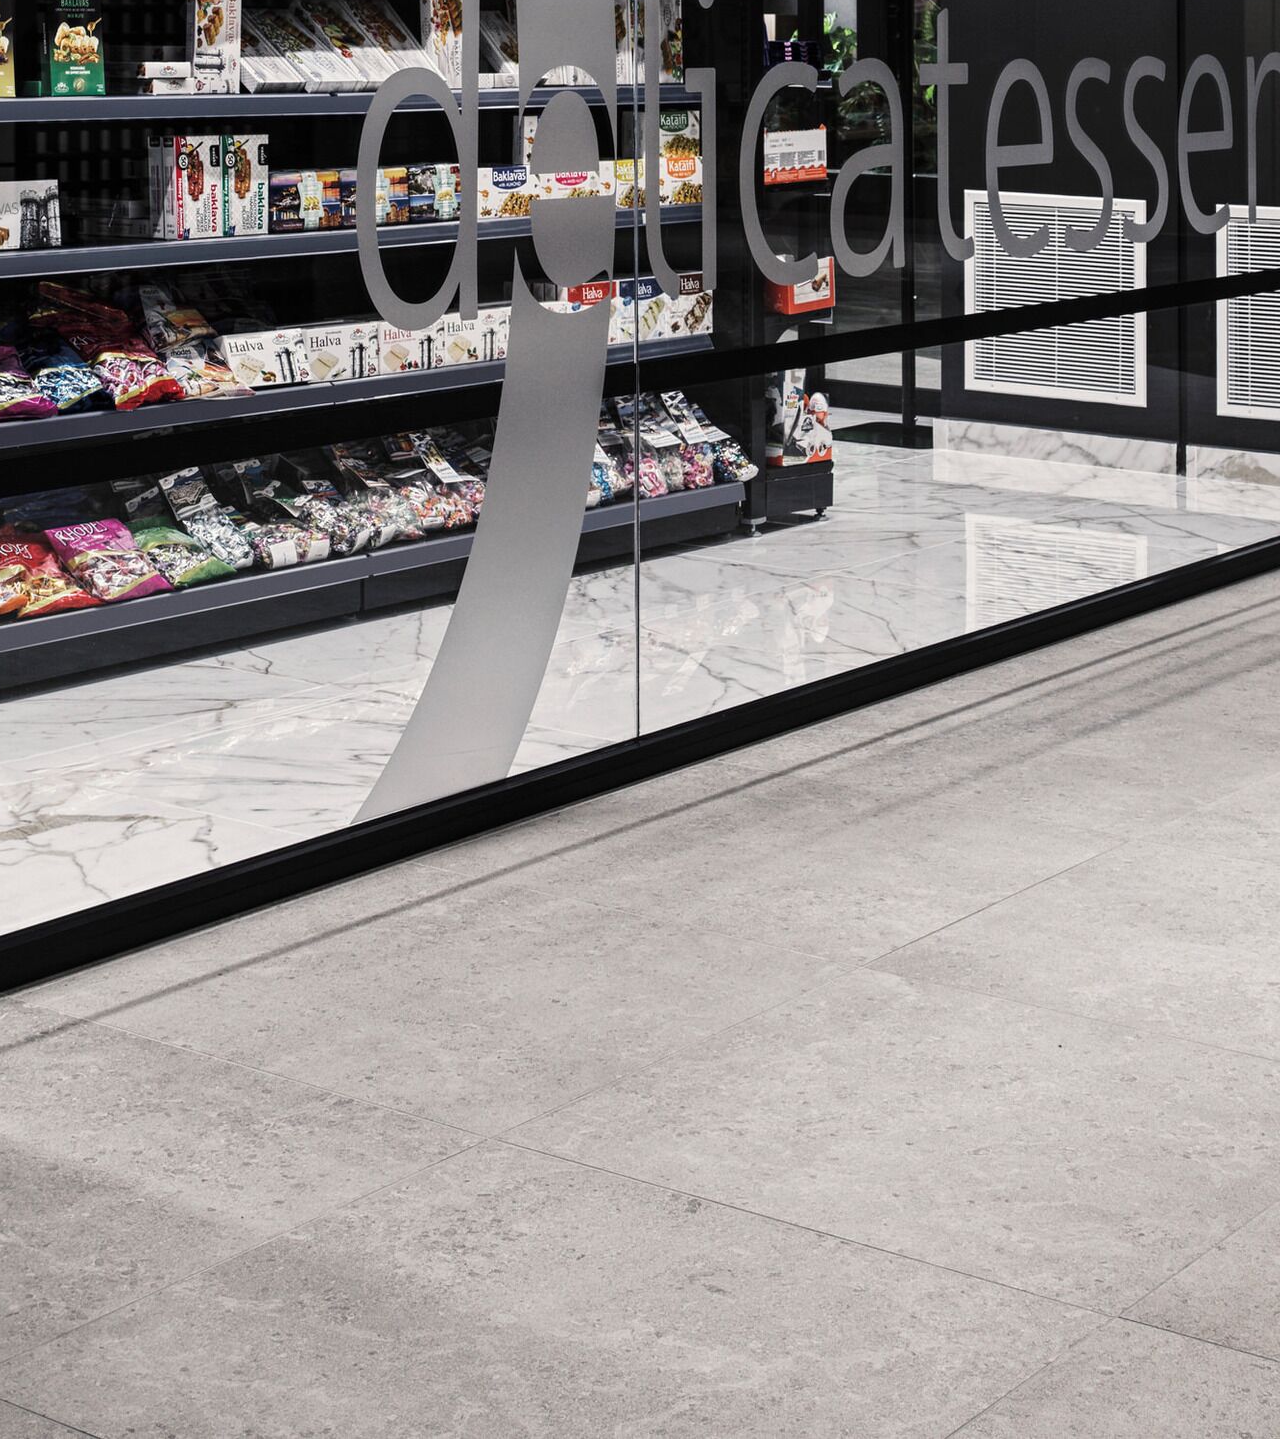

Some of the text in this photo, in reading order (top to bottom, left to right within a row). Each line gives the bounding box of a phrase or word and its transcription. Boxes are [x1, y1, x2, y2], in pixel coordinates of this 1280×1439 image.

[660, 113, 687, 126] Kataifi
[669, 160, 695, 171] Kataifi
[493, 170, 527, 182] Baklavas
[636, 282, 652, 295] alva
[681, 277, 700, 290] Halva
[582, 288, 603, 300] Halva
[447, 318, 475, 332] Halva
[383, 328, 412, 341] Halva
[228, 339, 265, 354] Halva
[310, 335, 342, 349] Halva
